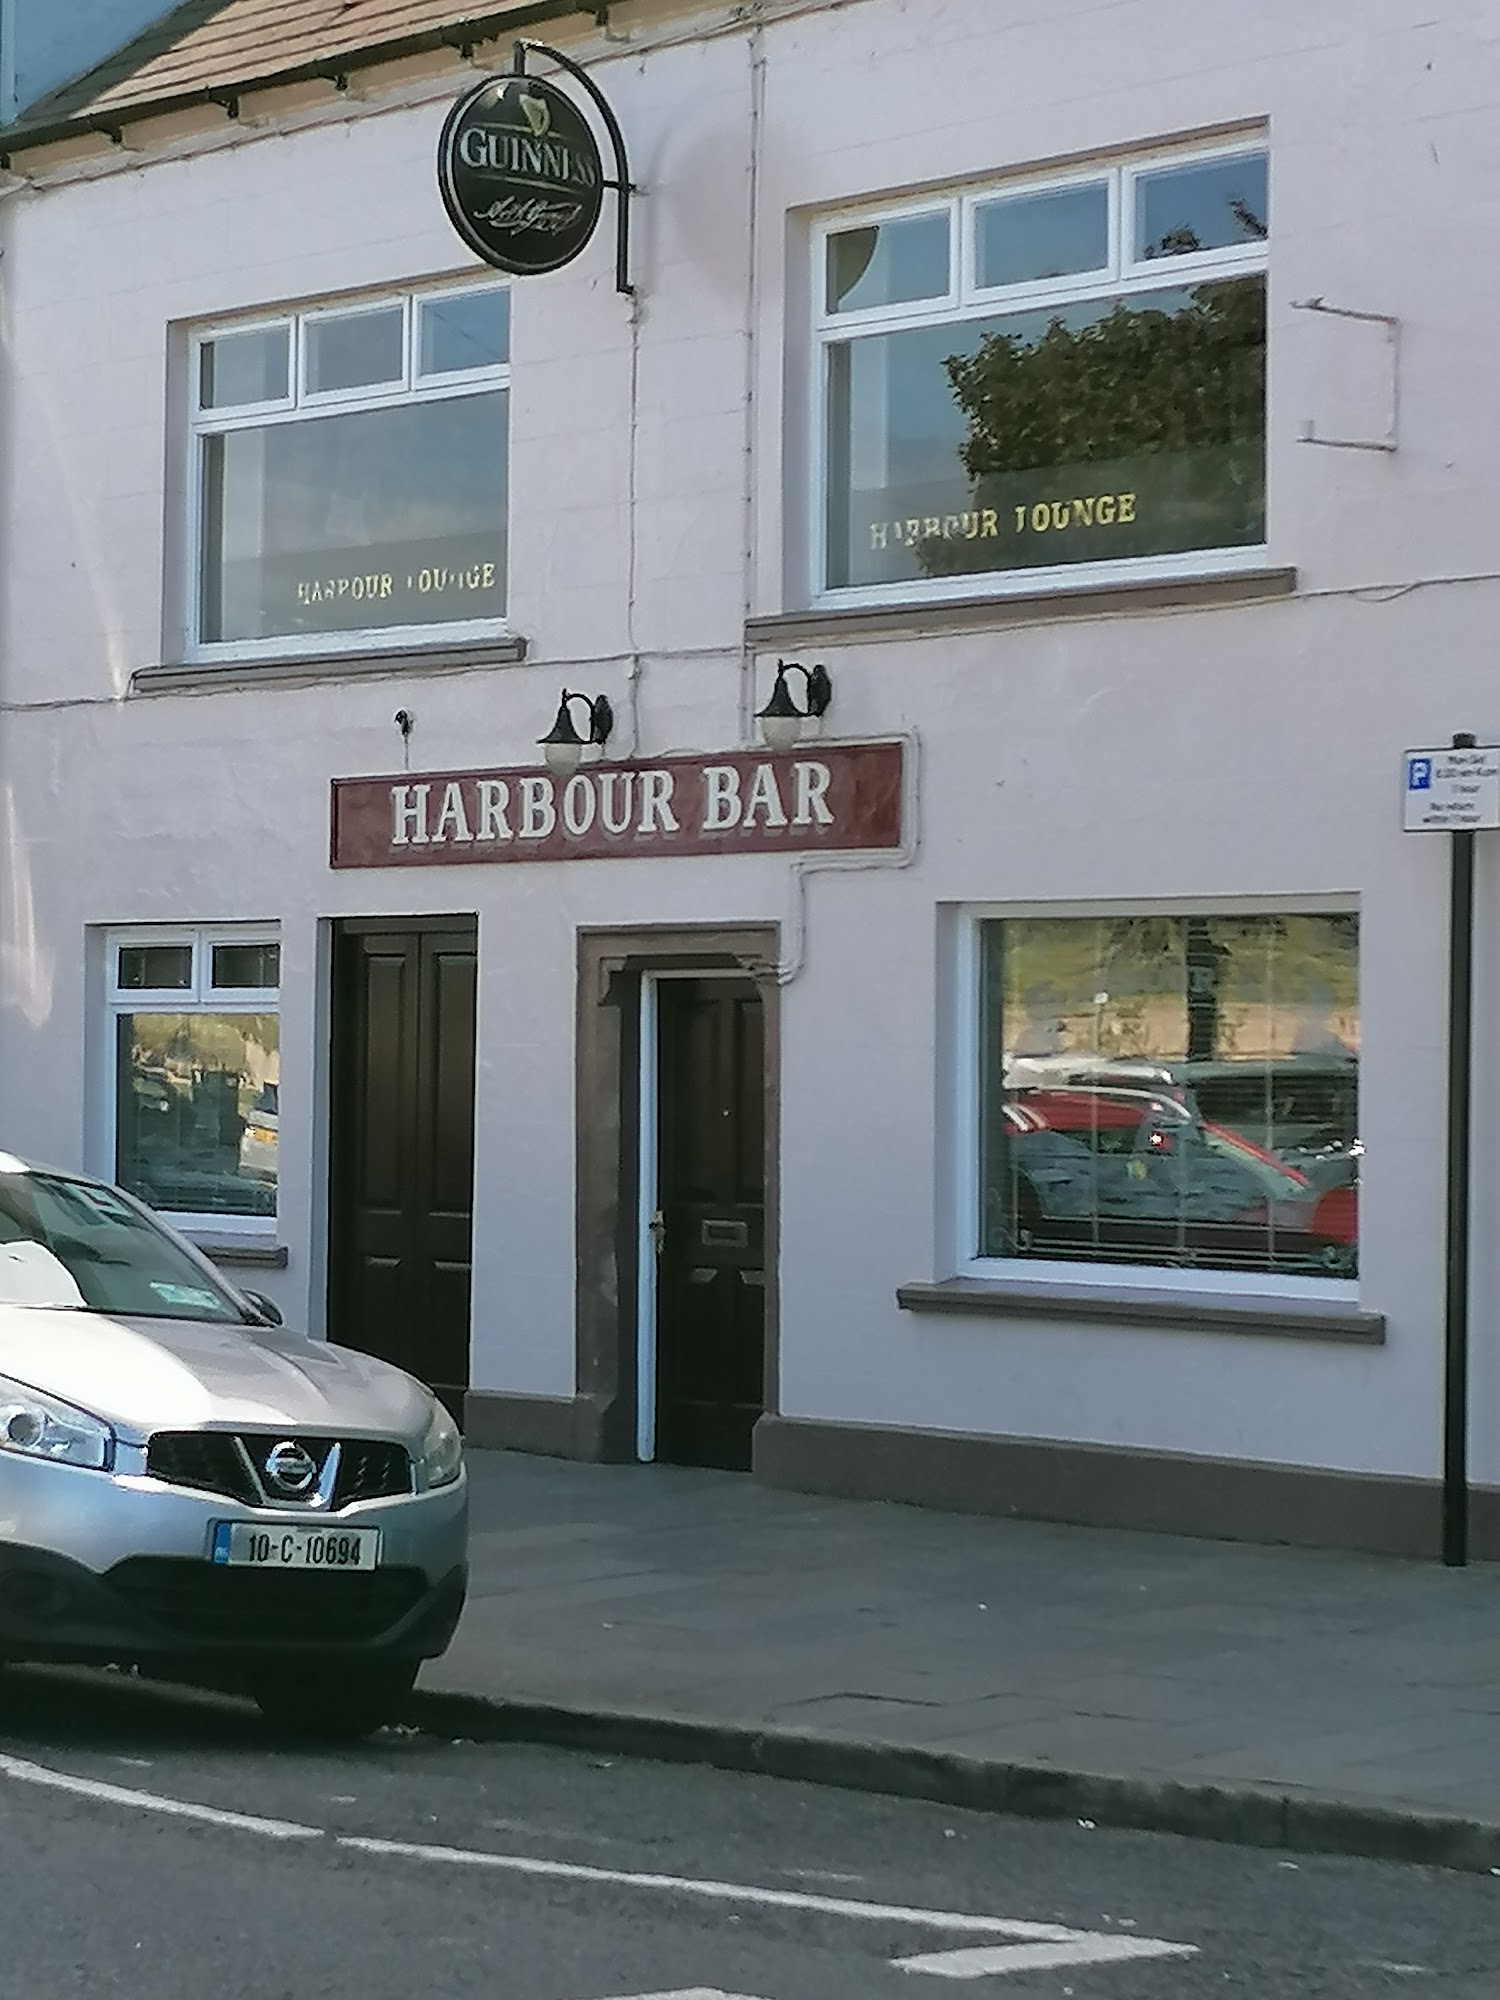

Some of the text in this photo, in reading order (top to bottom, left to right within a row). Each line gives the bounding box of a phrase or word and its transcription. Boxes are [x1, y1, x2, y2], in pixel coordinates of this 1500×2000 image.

[391, 762, 835, 845] HARBOUR BAR
[249, 1533, 362, 1566] 10-C-10694
